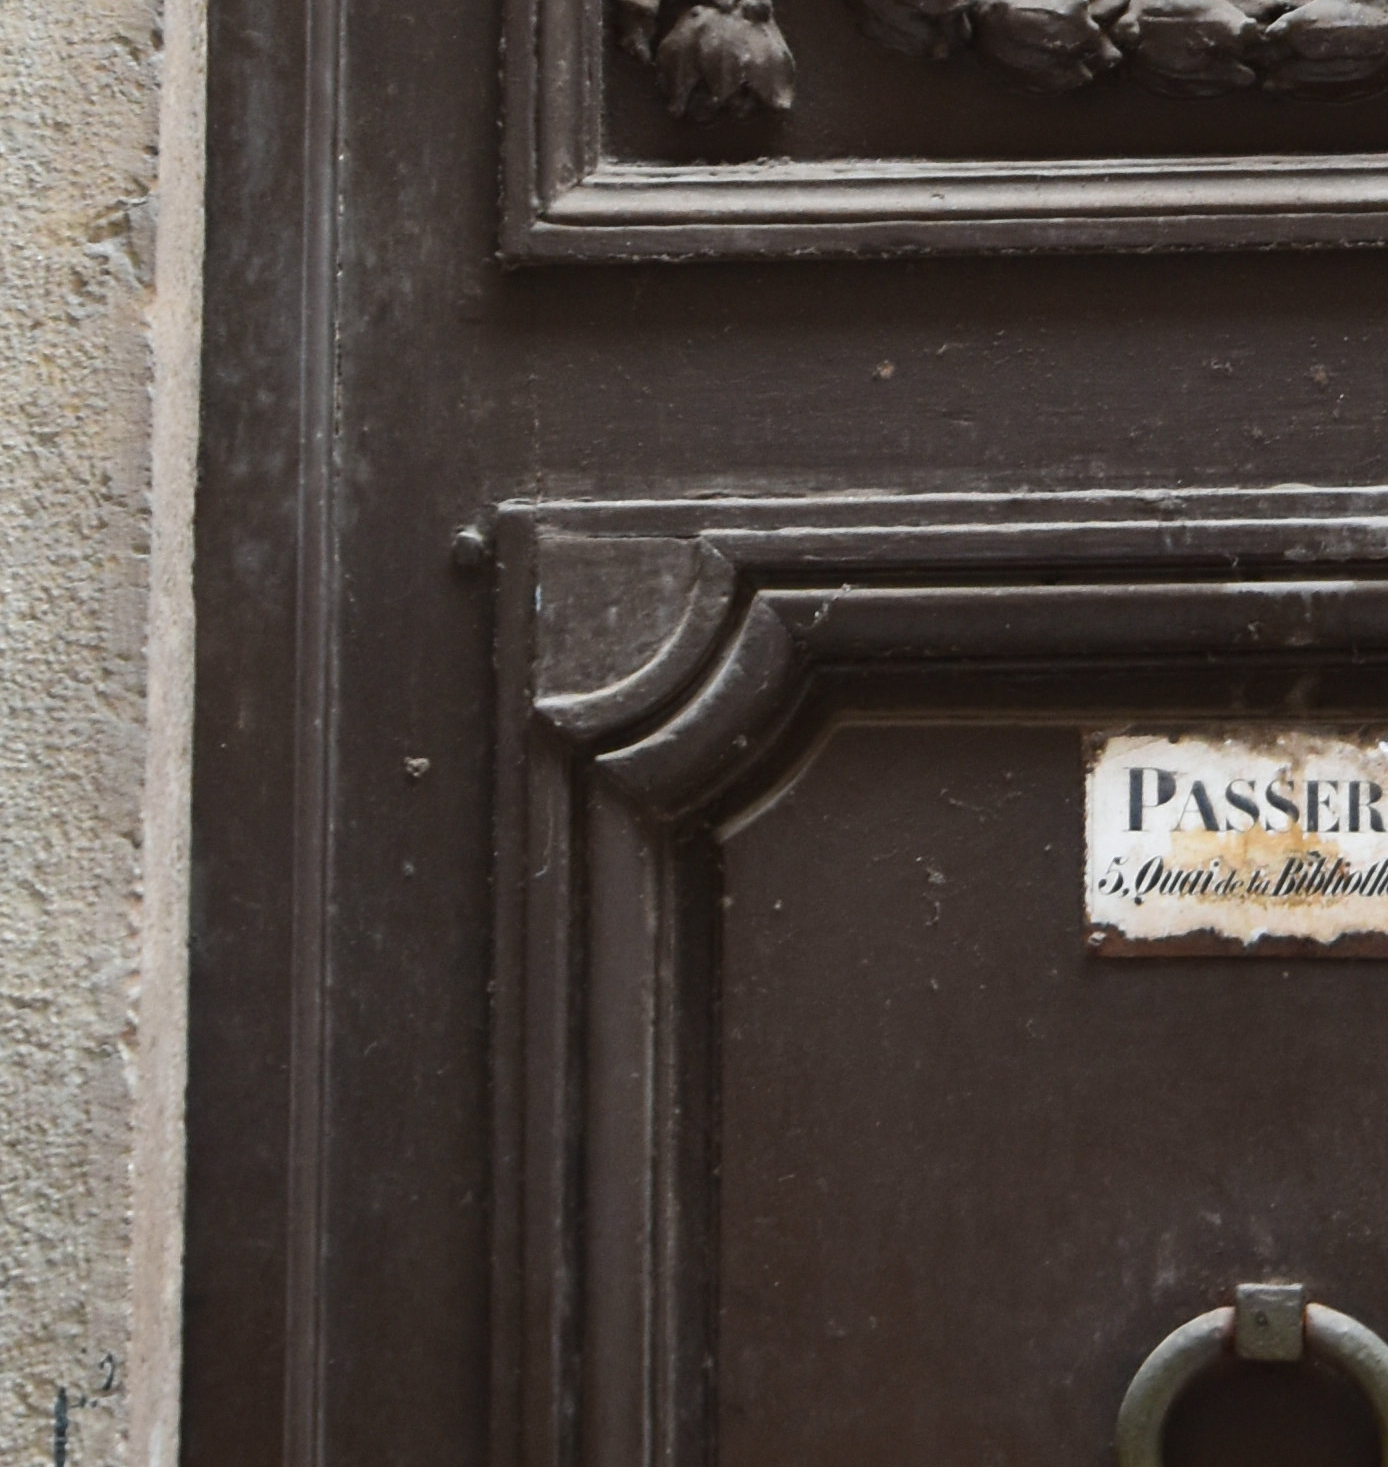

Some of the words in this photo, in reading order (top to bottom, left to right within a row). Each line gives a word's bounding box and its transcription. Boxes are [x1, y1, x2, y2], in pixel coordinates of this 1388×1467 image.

[1122, 766, 1387, 833] PASSER
[1133, 854, 1220, 905] Quai
[1213, 869, 1244, 897] de
[1245, 866, 1272, 897] la
